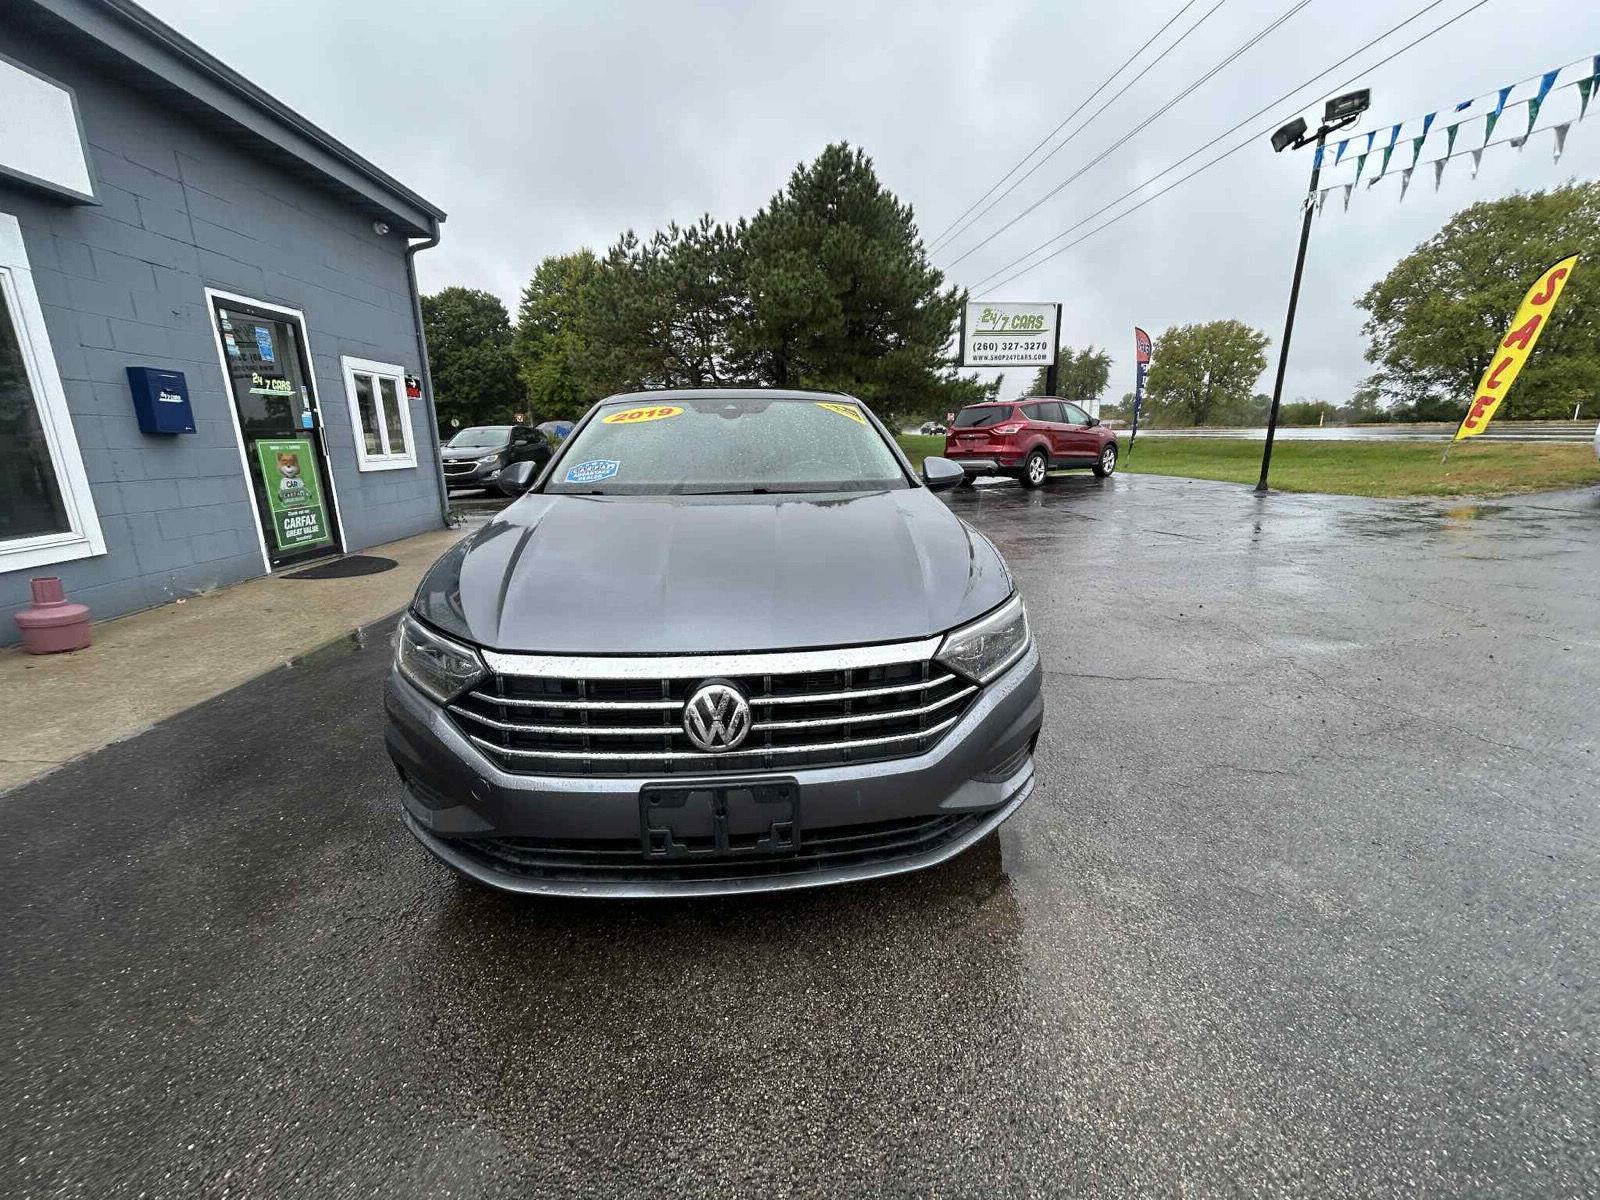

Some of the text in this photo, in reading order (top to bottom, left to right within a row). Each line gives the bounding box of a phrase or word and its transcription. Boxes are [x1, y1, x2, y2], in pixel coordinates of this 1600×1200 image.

[981, 307, 1044, 330] 24/7 CARS
[973, 341, 1047, 352] (260) 327-3270
[1465, 268, 1568, 428] SALE
[272, 379, 291, 391] CARS
[610, 408, 674, 422] 2019
[284, 514, 316, 530] CARFAX
